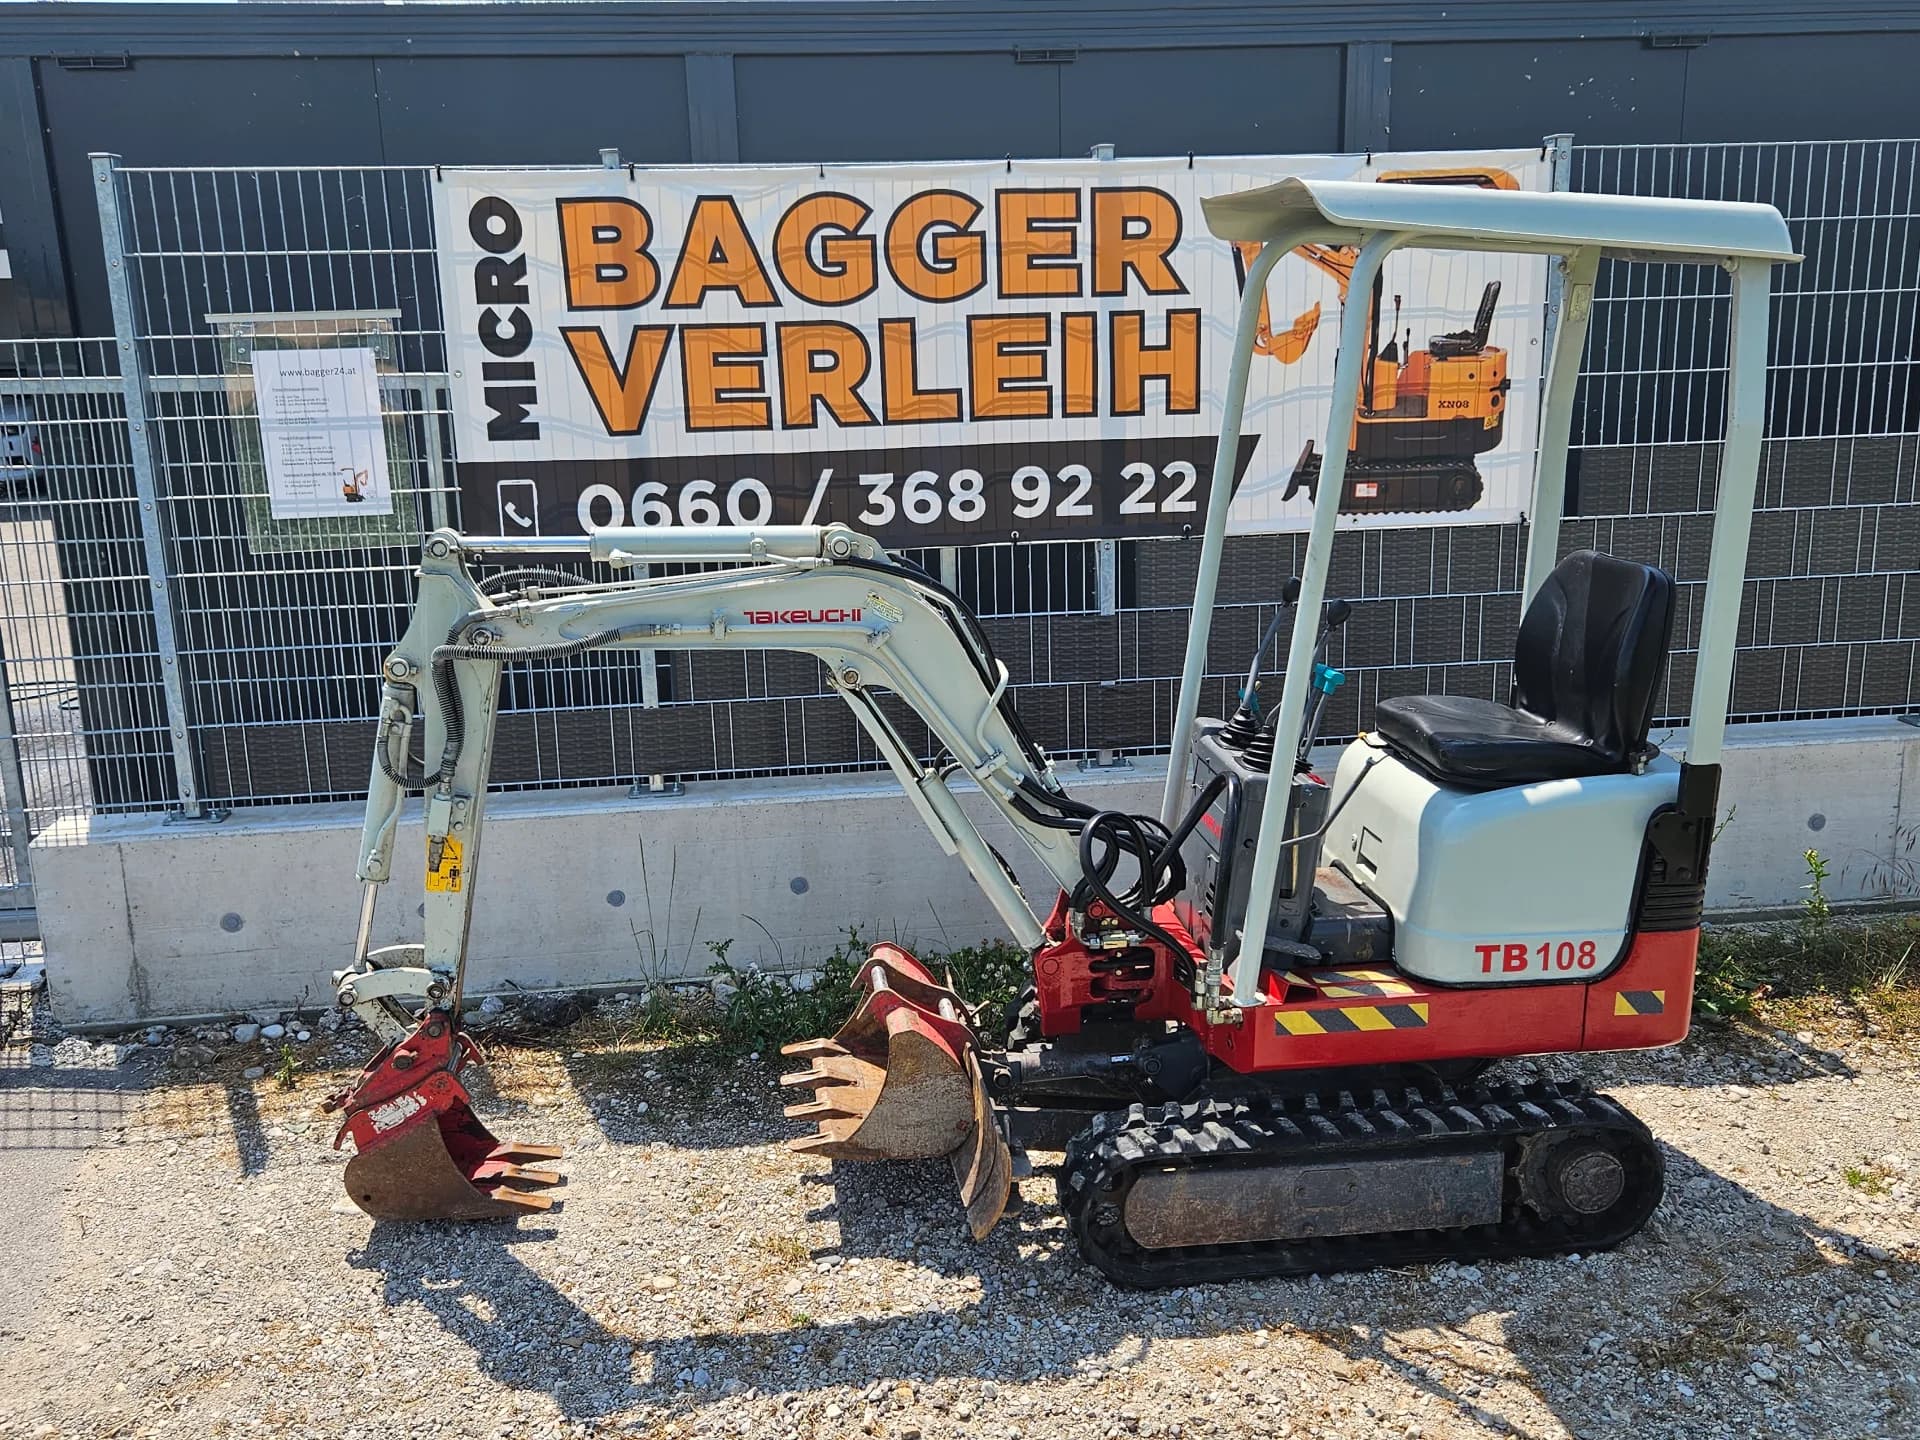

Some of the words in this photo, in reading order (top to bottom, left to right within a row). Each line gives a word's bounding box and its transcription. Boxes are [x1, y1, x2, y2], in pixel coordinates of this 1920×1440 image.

[556, 186, 1190, 311] BAGGER
[469, 196, 540, 441] MICRO
[280, 367, 357, 377] www.bagger24.at
[558, 308, 1201, 436] VERLEIH
[577, 476, 774, 533] 0660
[801, 467, 834, 526] /
[857, 469, 986, 526] 368
[1010, 463, 1094, 519] 92
[1118, 460, 1198, 515] 22
[743, 608, 862, 625] TAKEUCHI
[1474, 943, 1528, 973] TB
[1536, 940, 1596, 971] 108
